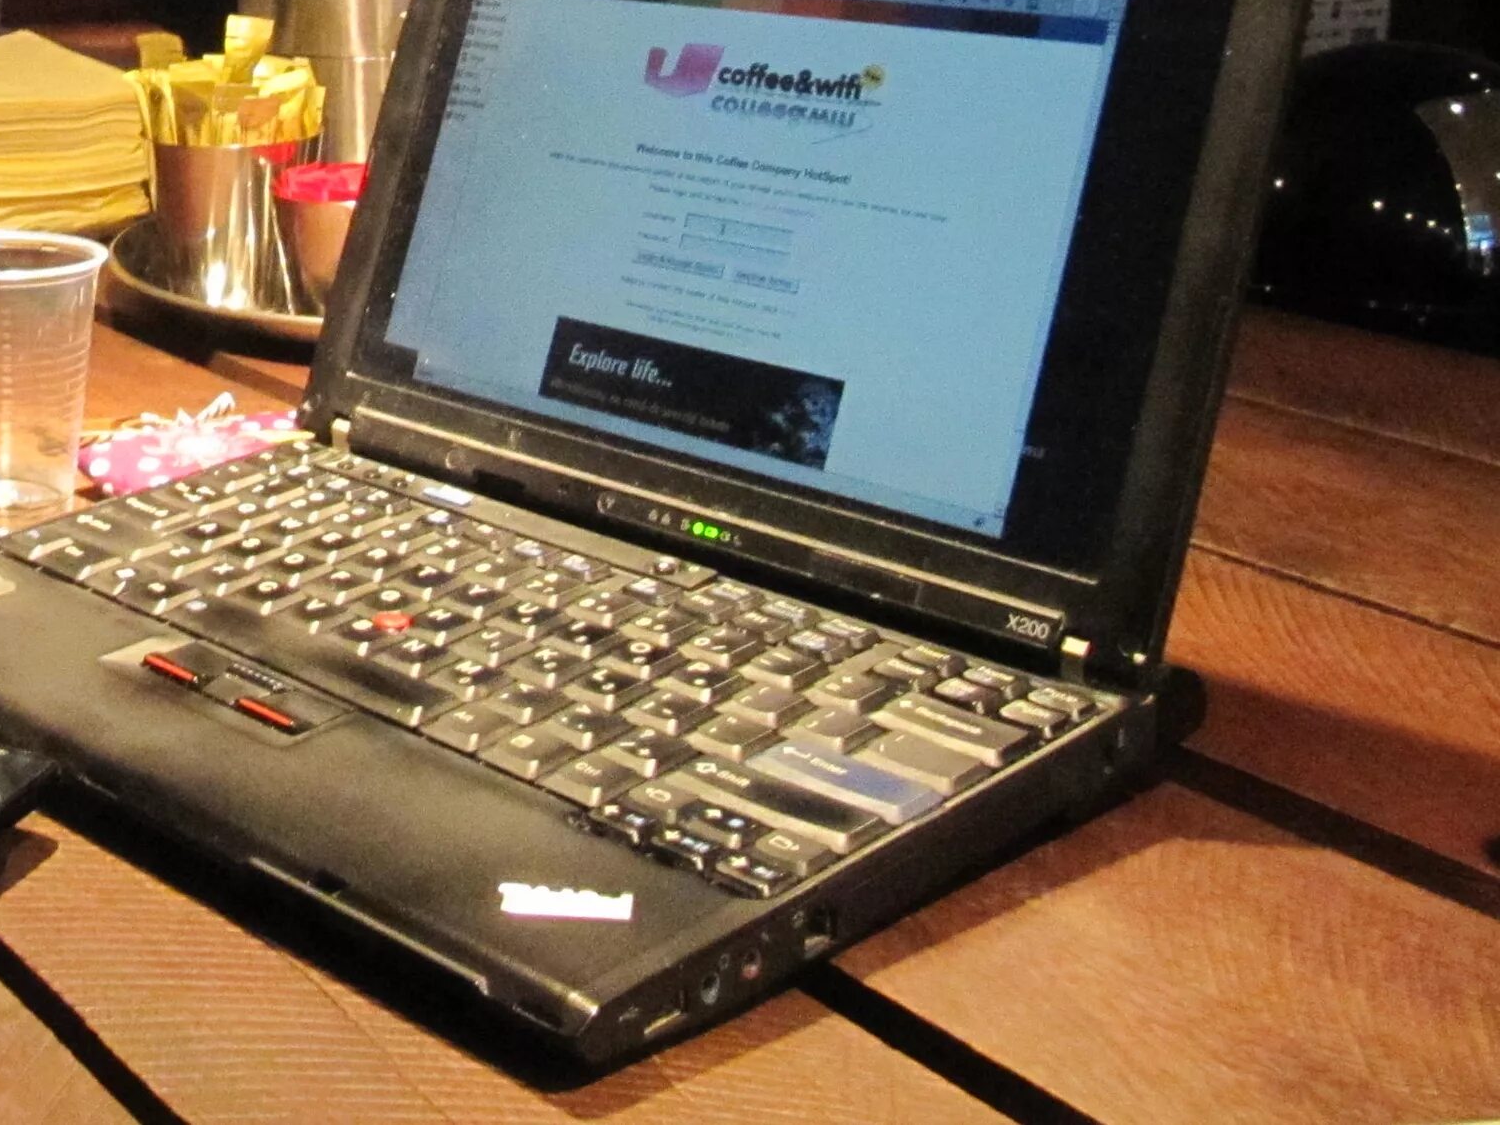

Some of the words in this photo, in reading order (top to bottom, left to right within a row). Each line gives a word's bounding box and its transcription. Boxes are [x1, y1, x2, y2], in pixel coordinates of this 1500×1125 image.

[718, 61, 863, 101] coffee&wifi
[715, 154, 750, 170] Coffee
[751, 159, 803, 180] Company
[568, 342, 628, 376] Explore
[631, 356, 674, 389] life...
[1005, 610, 1051, 641] X200
